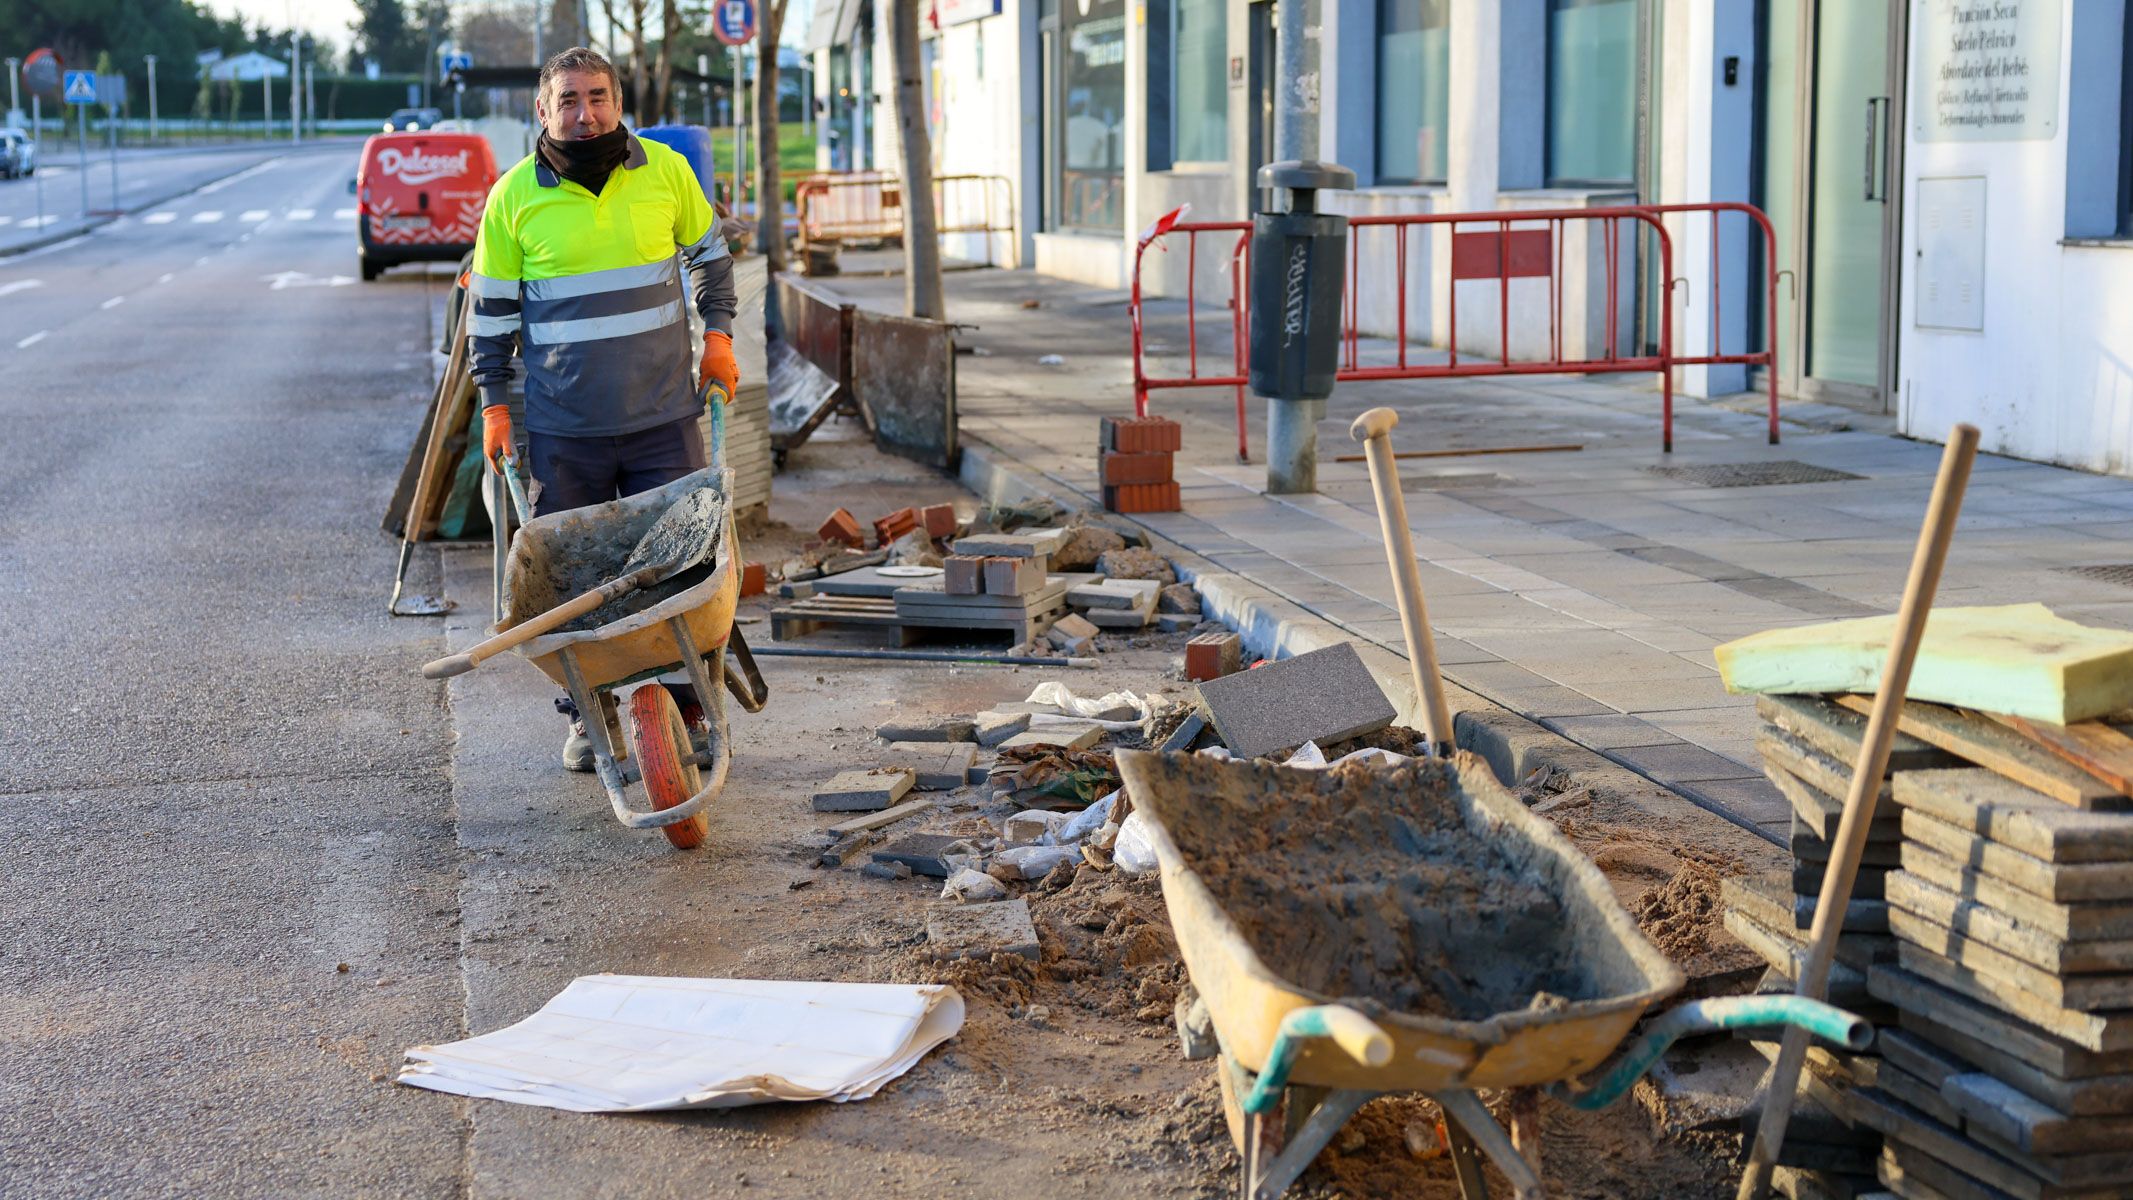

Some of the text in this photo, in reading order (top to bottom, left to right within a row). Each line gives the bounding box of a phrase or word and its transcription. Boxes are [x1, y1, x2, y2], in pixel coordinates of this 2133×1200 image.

[1993, 1, 2018, 20] Seca
[1952, 31, 1978, 51] Suelo
[1939, 59, 1982, 83] Abordaje
[1984, 56, 2000, 78] del
[377, 147, 468, 177] Dulcesol
